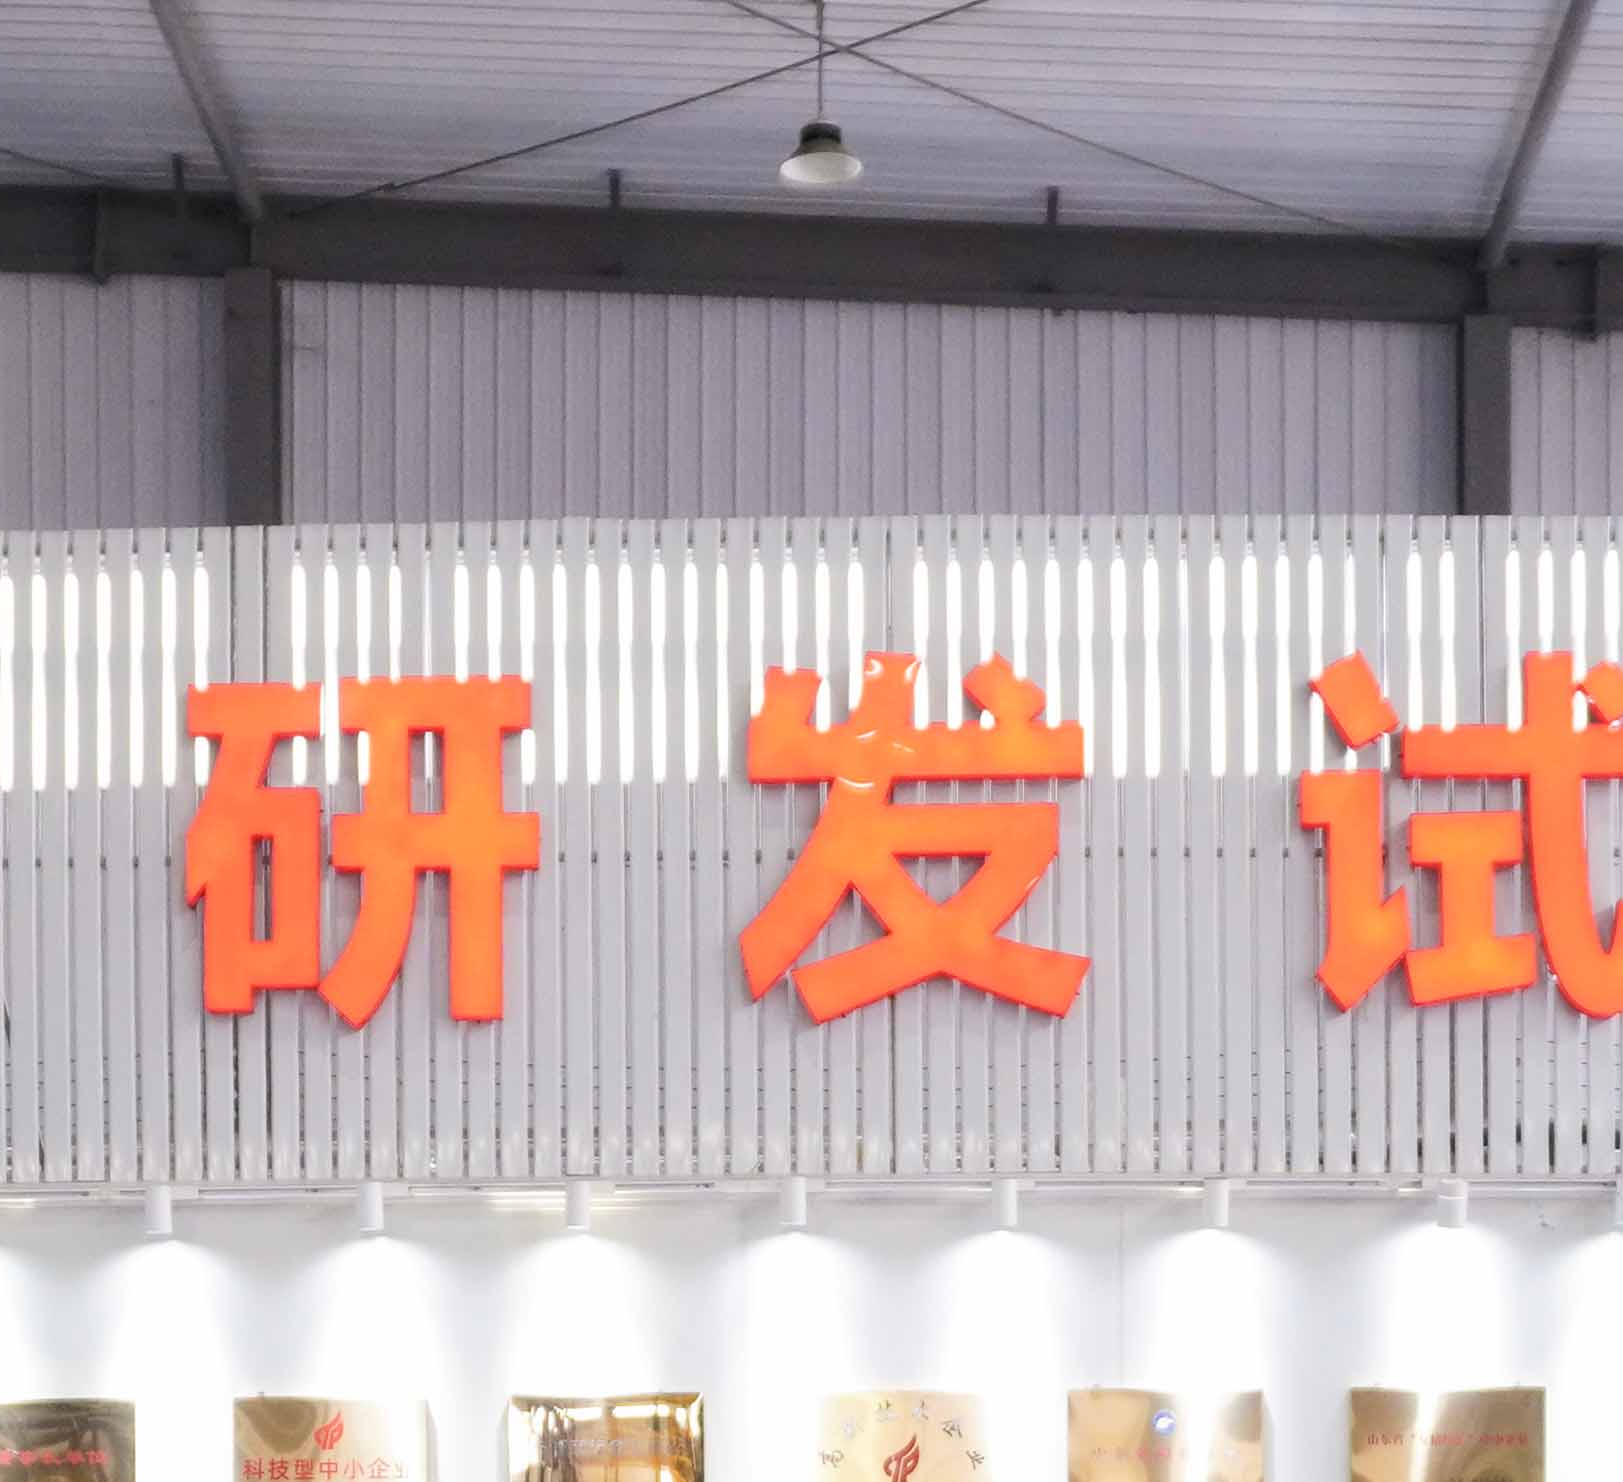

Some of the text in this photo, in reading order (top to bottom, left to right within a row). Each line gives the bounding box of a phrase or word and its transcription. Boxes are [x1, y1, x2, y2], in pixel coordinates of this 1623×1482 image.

[242, 1456, 409, 1481] 科技型中小企业
